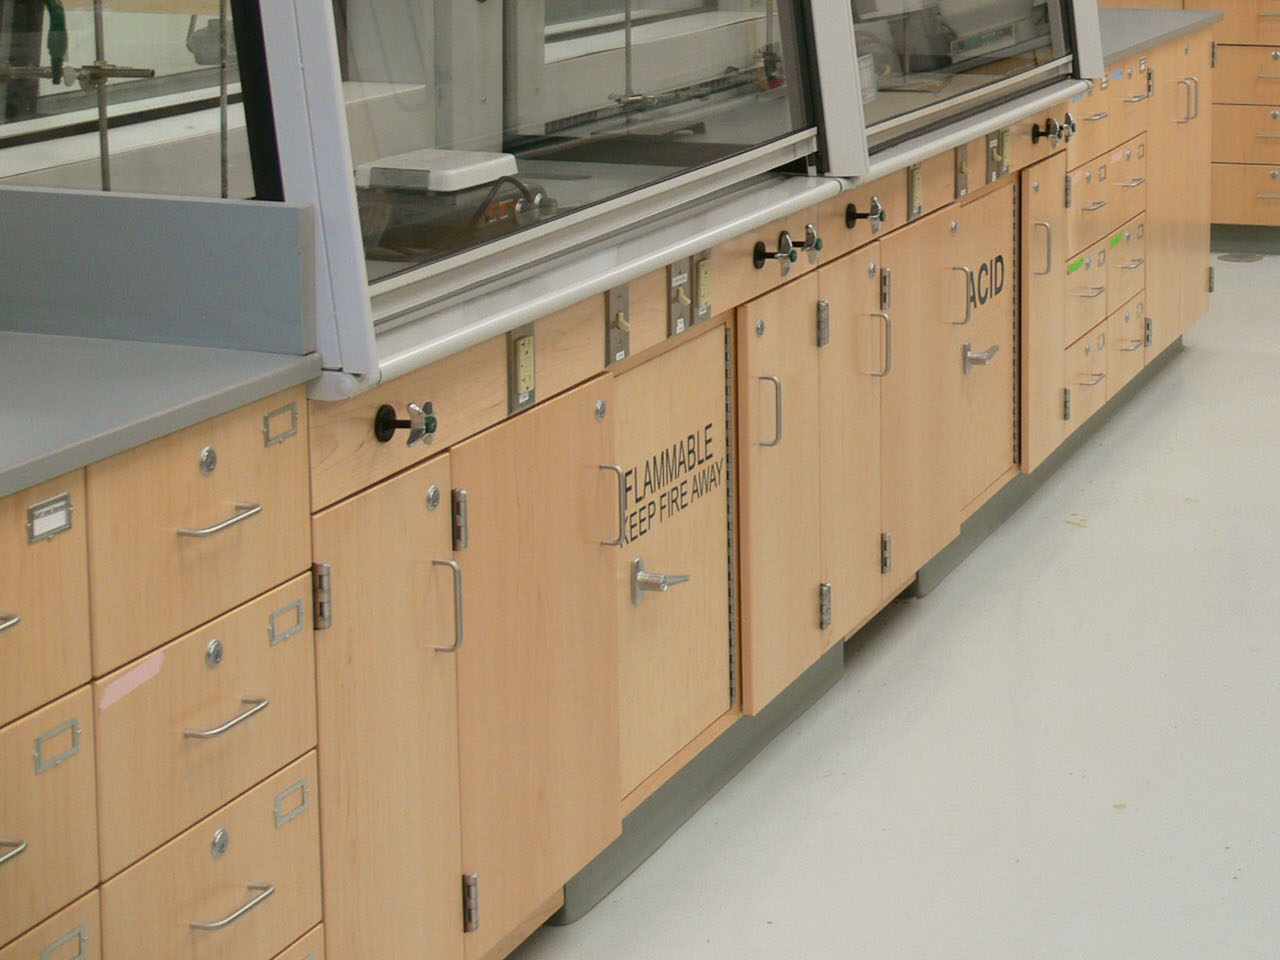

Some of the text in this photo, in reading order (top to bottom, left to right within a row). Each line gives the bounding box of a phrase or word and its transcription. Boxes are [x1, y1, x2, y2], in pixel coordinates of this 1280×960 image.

[969, 254, 1005, 309] ACID
[624, 422, 714, 511] FLAMMABLE
[660, 480, 688, 524] FIRE
[691, 457, 724, 503] AWAY
